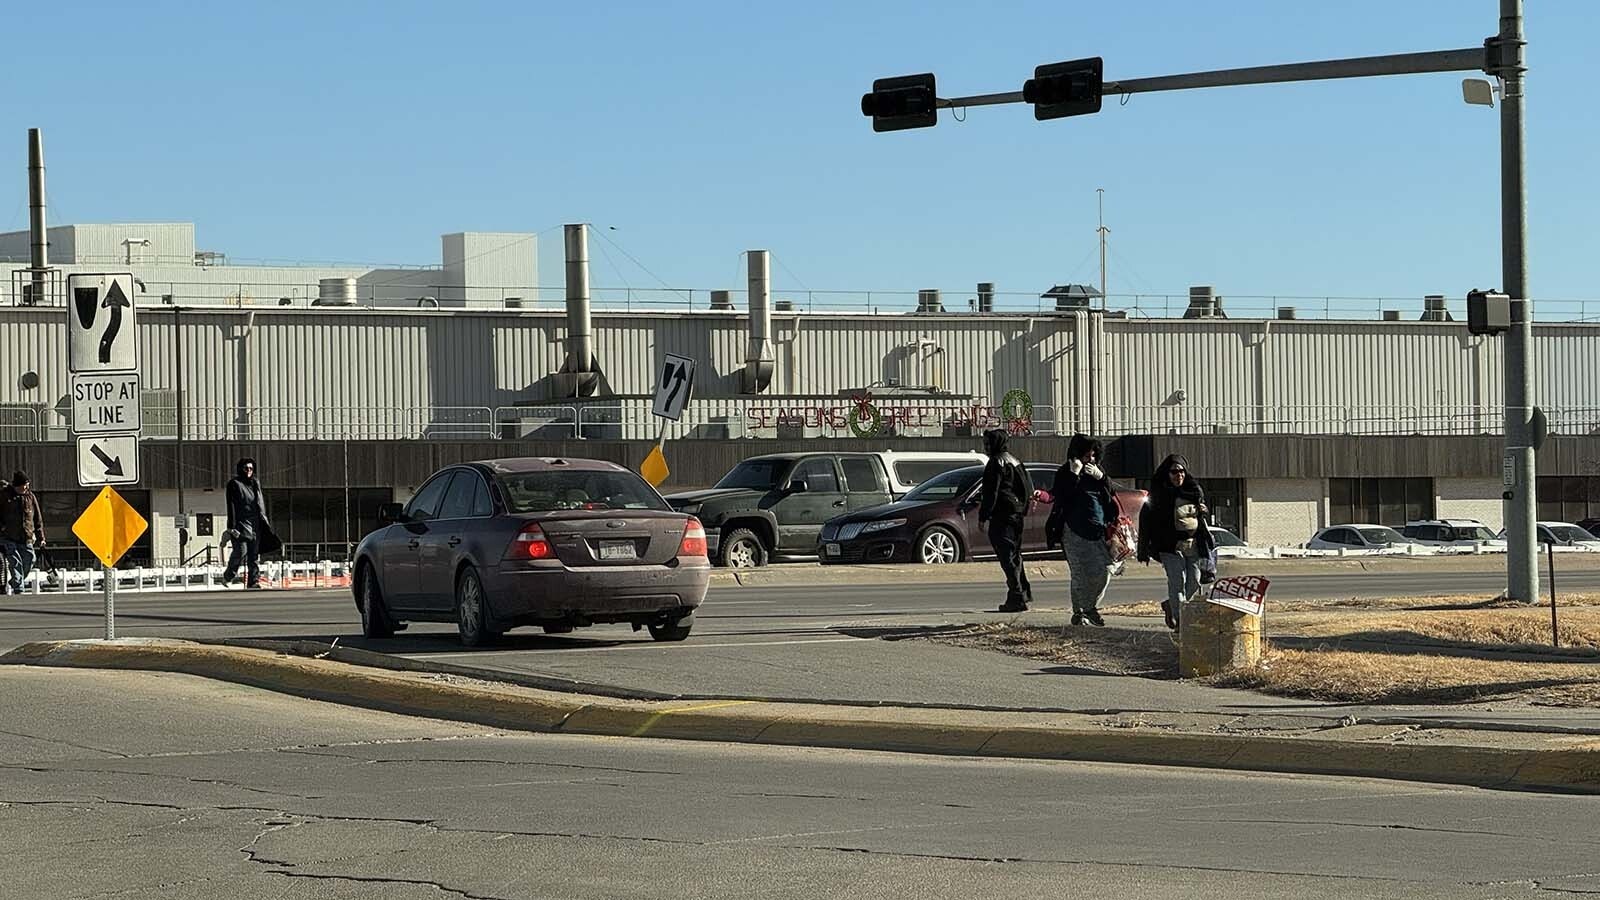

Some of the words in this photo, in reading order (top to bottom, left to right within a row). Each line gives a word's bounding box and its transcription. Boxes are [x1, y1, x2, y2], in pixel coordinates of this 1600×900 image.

[75, 382, 114, 401] STOP
[119, 381, 137, 400] AT
[88, 405, 125, 425] LINE
[1216, 580, 1262, 602] RENT
[1231, 576, 1262, 590] OR
